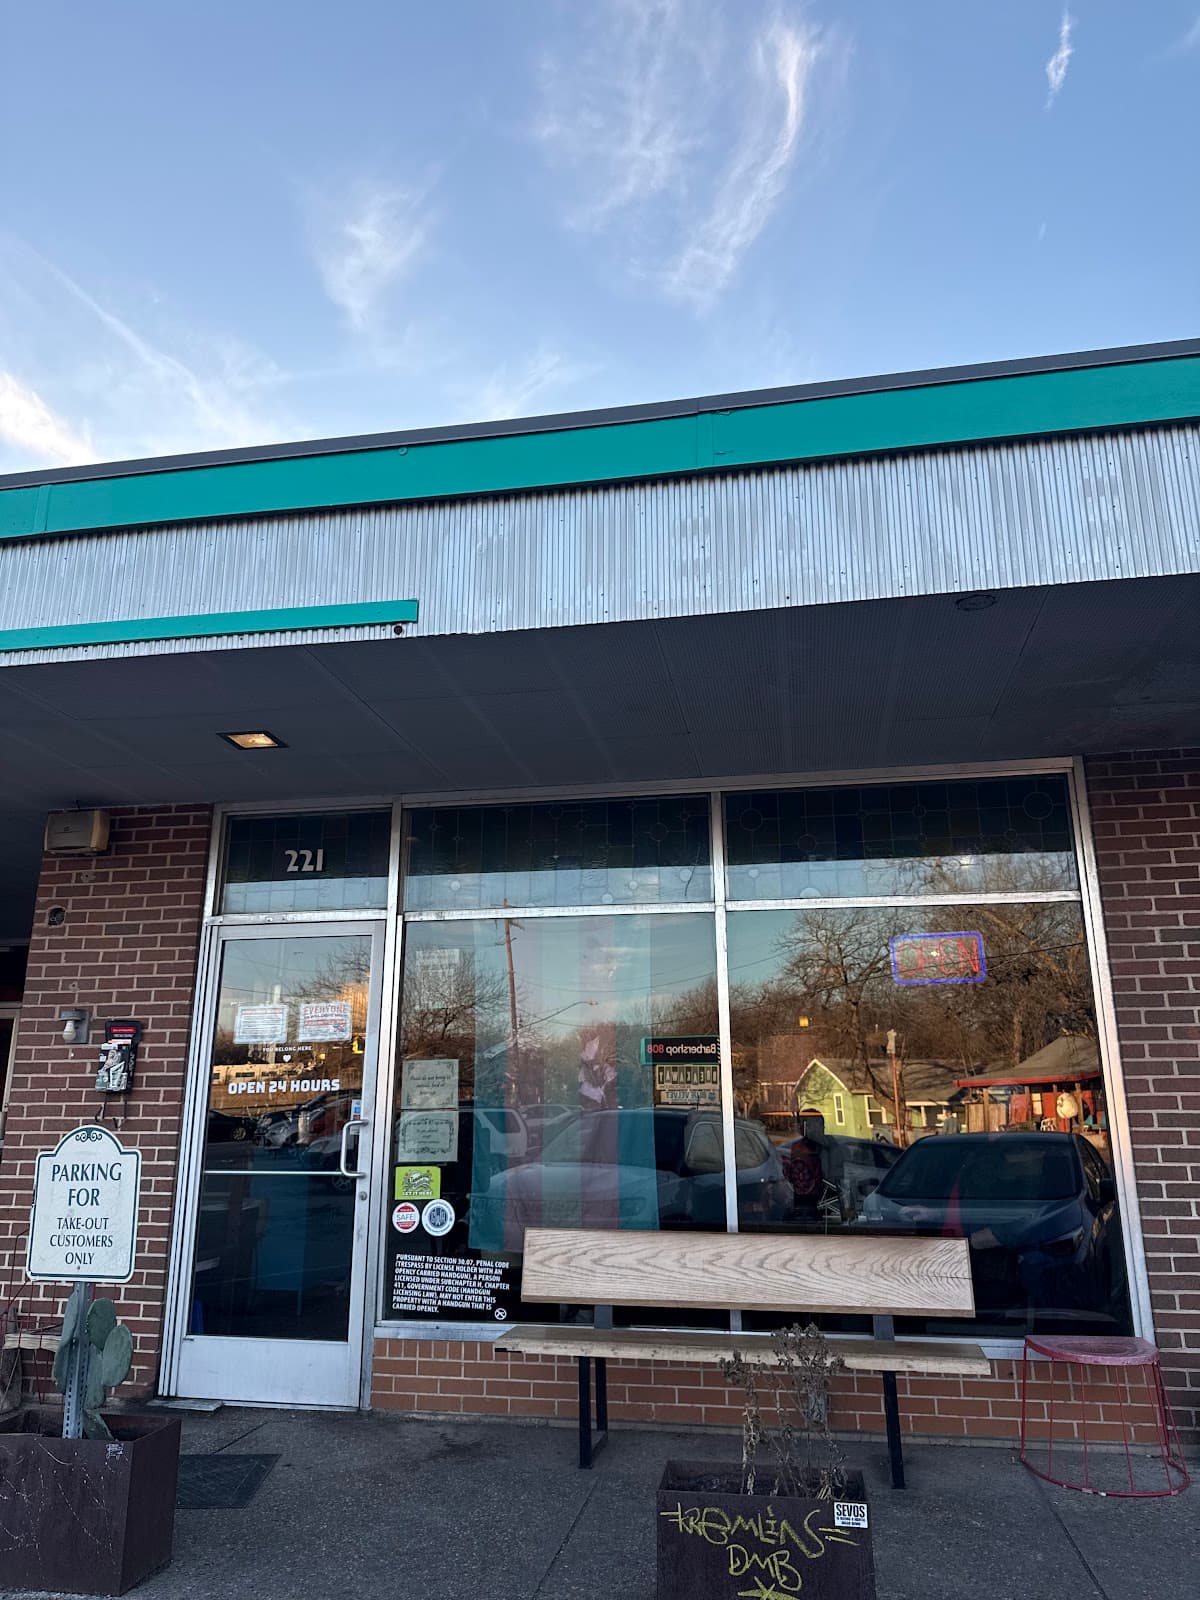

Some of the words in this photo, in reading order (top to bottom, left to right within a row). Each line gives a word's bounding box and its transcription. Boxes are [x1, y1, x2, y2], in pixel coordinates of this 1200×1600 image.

[285, 849, 324, 872] 221
[896, 938, 980, 976] OPEN
[228, 1081, 266, 1094] OPEN
[269, 1081, 287, 1093] 24
[291, 1079, 340, 1092] HOURS
[52, 1163, 122, 1182] PARKING
[68, 1188, 100, 1207] FOR
[57, 1217, 109, 1230] TAKE-OUT
[50, 1235, 113, 1247] CUSTOMERS
[65, 1251, 95, 1265] ONLY
[416, 1269, 440, 1277] CARRIED
[407, 1283, 444, 1291] GOVERNMENT
[441, 1278, 476, 1287] SUBCHAPTER
[485, 1282, 510, 1290] CHAPTER
[393, 1289, 422, 1297] LICENSING
[392, 1303, 416, 1311] CARRIED
[442, 1300, 470, 1308] HANDGUN
[471, 1302, 485, 1310] THAT
[836, 1504, 865, 1517] SEVOS
